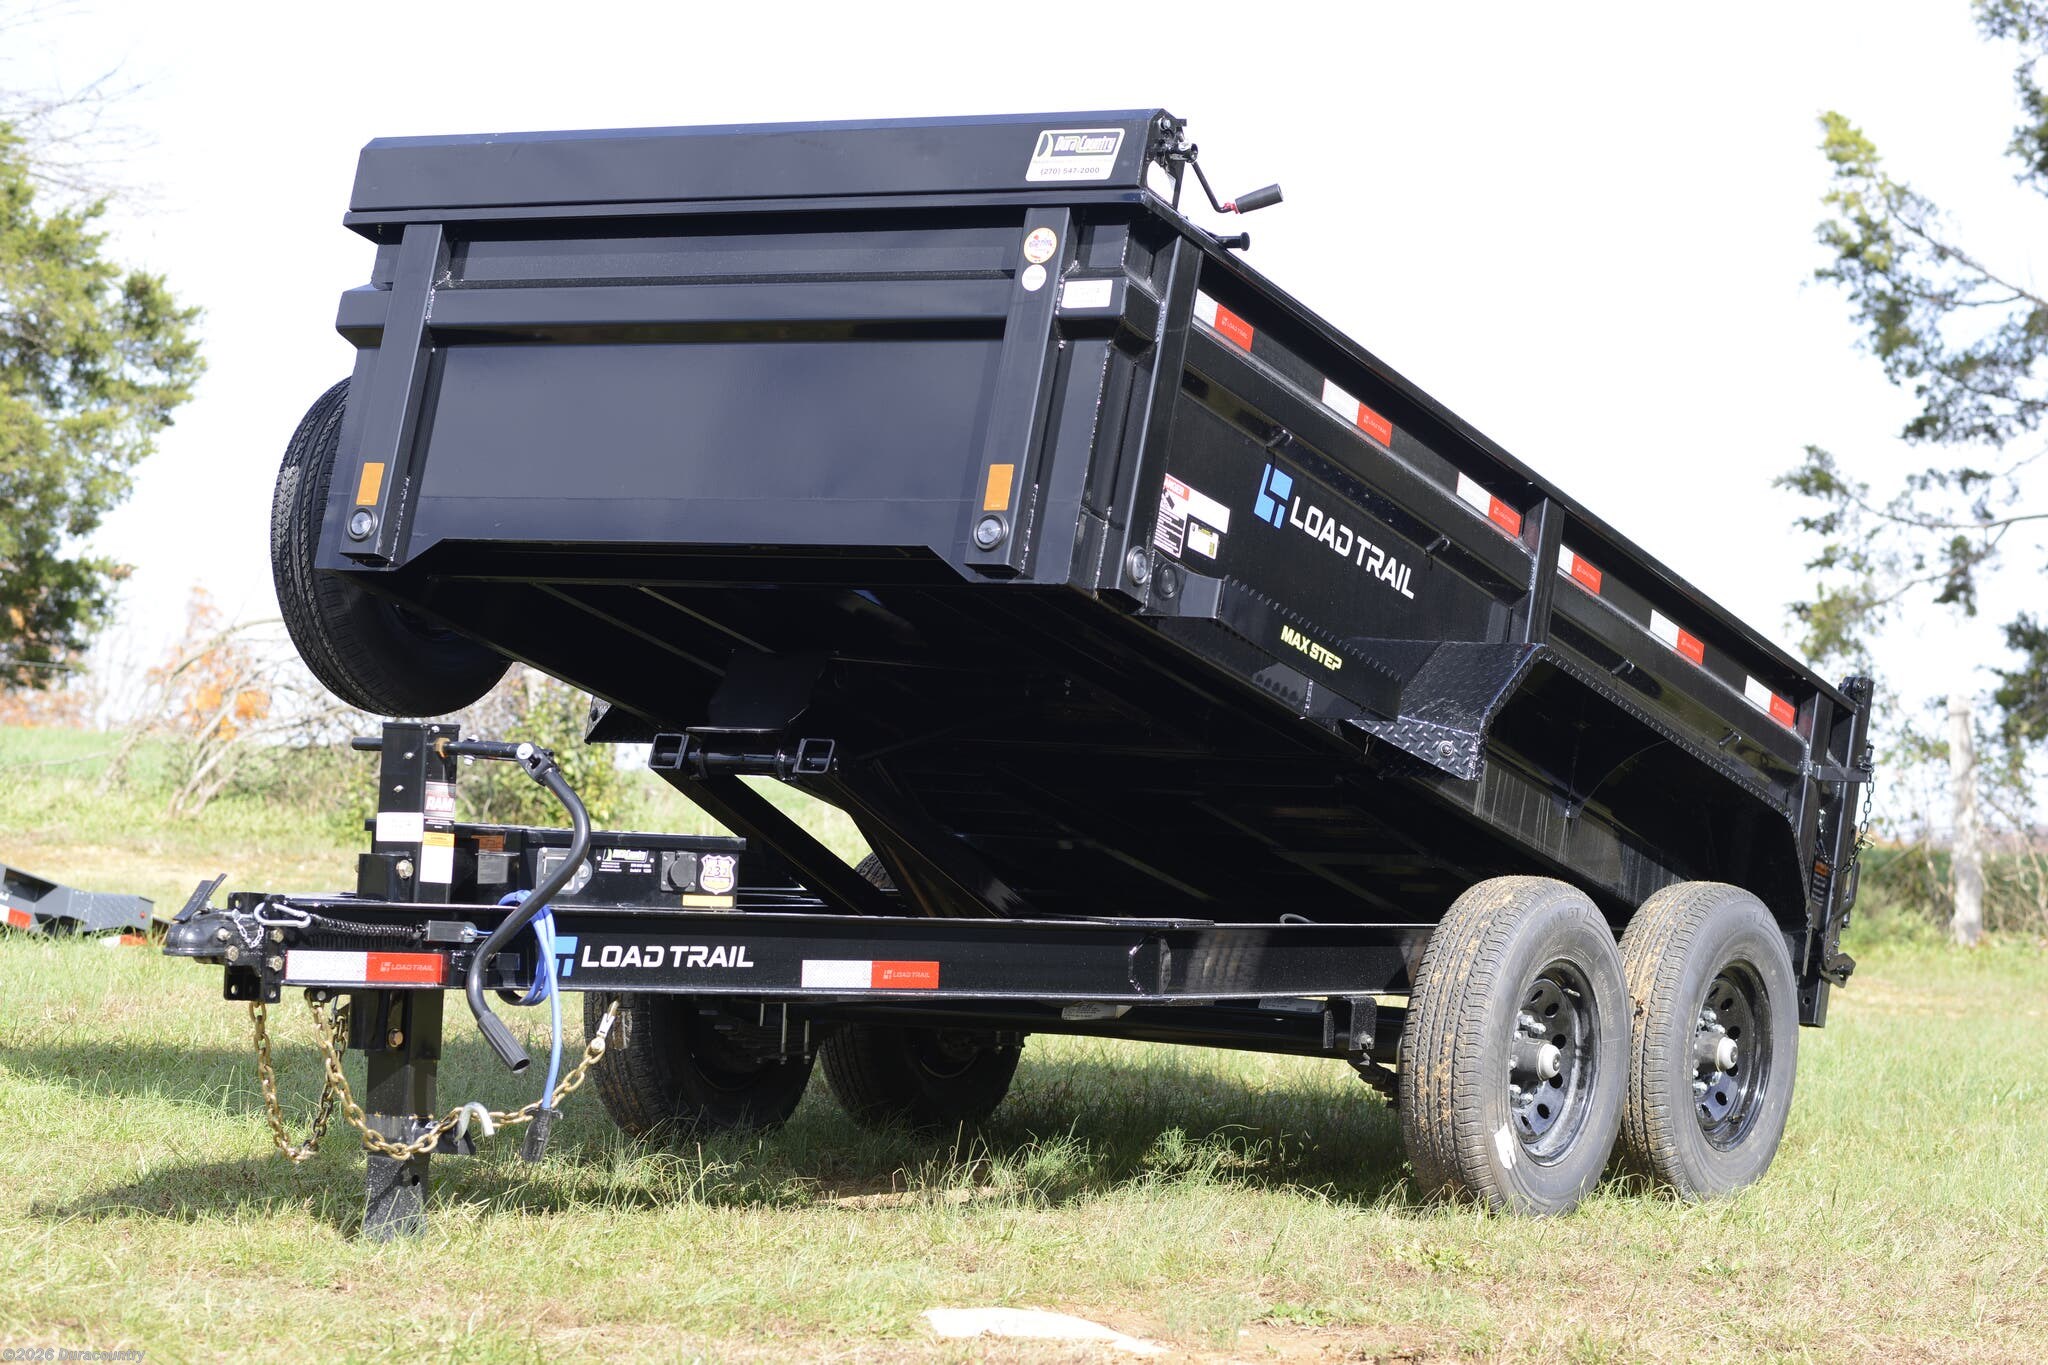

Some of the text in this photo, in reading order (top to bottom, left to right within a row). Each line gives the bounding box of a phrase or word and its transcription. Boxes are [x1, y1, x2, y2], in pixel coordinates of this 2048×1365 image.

[1040, 168, 1061, 176] (270)
[1290, 496, 1414, 600] LOAD TRAIL
[1281, 626, 1342, 670] MAX STEP
[581, 945, 754, 968] LOAD TRAIL
